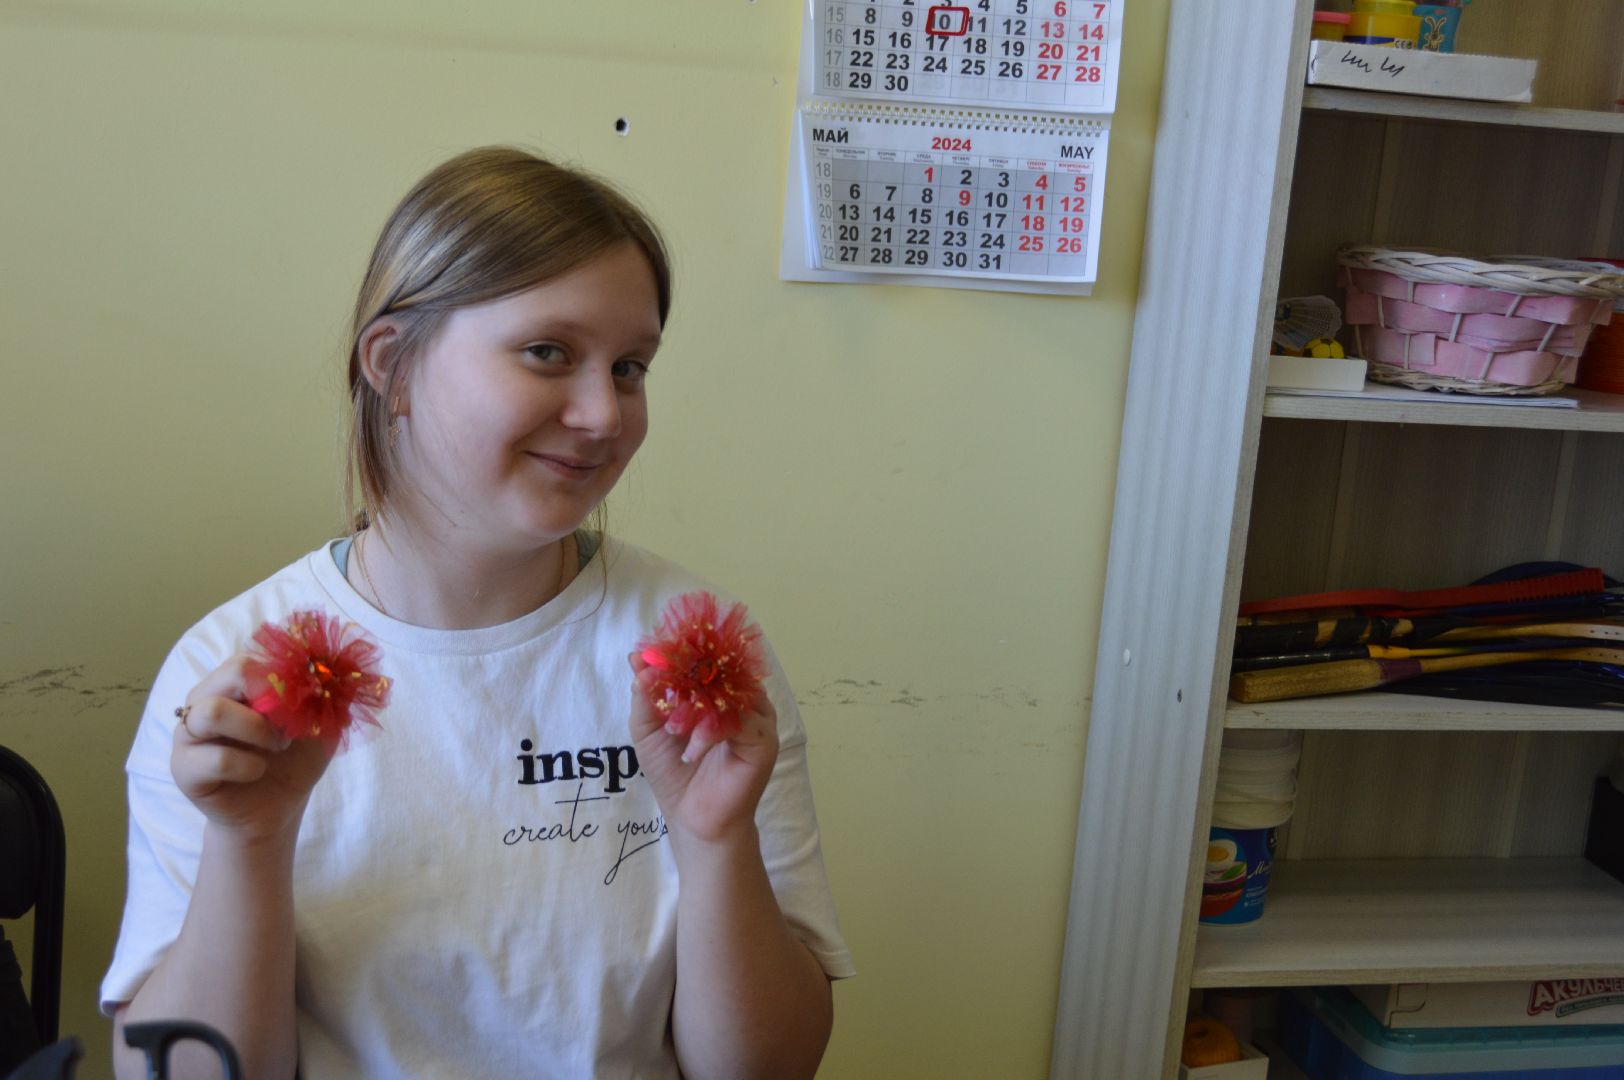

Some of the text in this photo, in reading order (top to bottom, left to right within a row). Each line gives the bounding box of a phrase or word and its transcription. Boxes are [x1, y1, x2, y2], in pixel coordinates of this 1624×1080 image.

[827, 6, 844, 23] 15
[865, 8, 876, 24] 8
[902, 11, 913, 27] 9
[968, 16, 987, 32] 11
[1002, 19, 1026, 35] 12
[1041, 21, 1064, 38] 13
[1079, 24, 1104, 40] 14
[1016, 0, 1028, 14] 5
[1054, 1, 1067, 17] 6
[1093, 4, 1105, 19] 7
[826, 28, 1101, 61] 16 15 16 17 18 19 20 21
[826, 49, 1101, 82] 17 22 23 24 25 26 27 28
[826, 72, 909, 91] 18 29 30
[813, 128, 849, 143] МАЙ
[931, 137, 971, 151] 2024
[1060, 145, 1094, 159] MAY
[816, 162, 1086, 192] 18 1 2 3 4 5
[817, 183, 1085, 212] 19 6 7 8 9 10 11 12
[819, 204, 1084, 233] 20 13 14 15 16 17 18 19
[838, 225, 859, 241] 20
[871, 227, 892, 243] 21
[906, 229, 930, 245] 22
[942, 231, 967, 247] 23
[980, 233, 1005, 249] 24
[1018, 235, 1044, 252] 25
[1056, 237, 1082, 253] 26
[840, 246, 859, 262] 27
[871, 248, 892, 264] 28
[905, 250, 928, 265] 29
[942, 251, 967, 267] 30
[979, 253, 1002, 270] 31
[517, 738, 645, 793] insp
[503, 782, 610, 845] create
